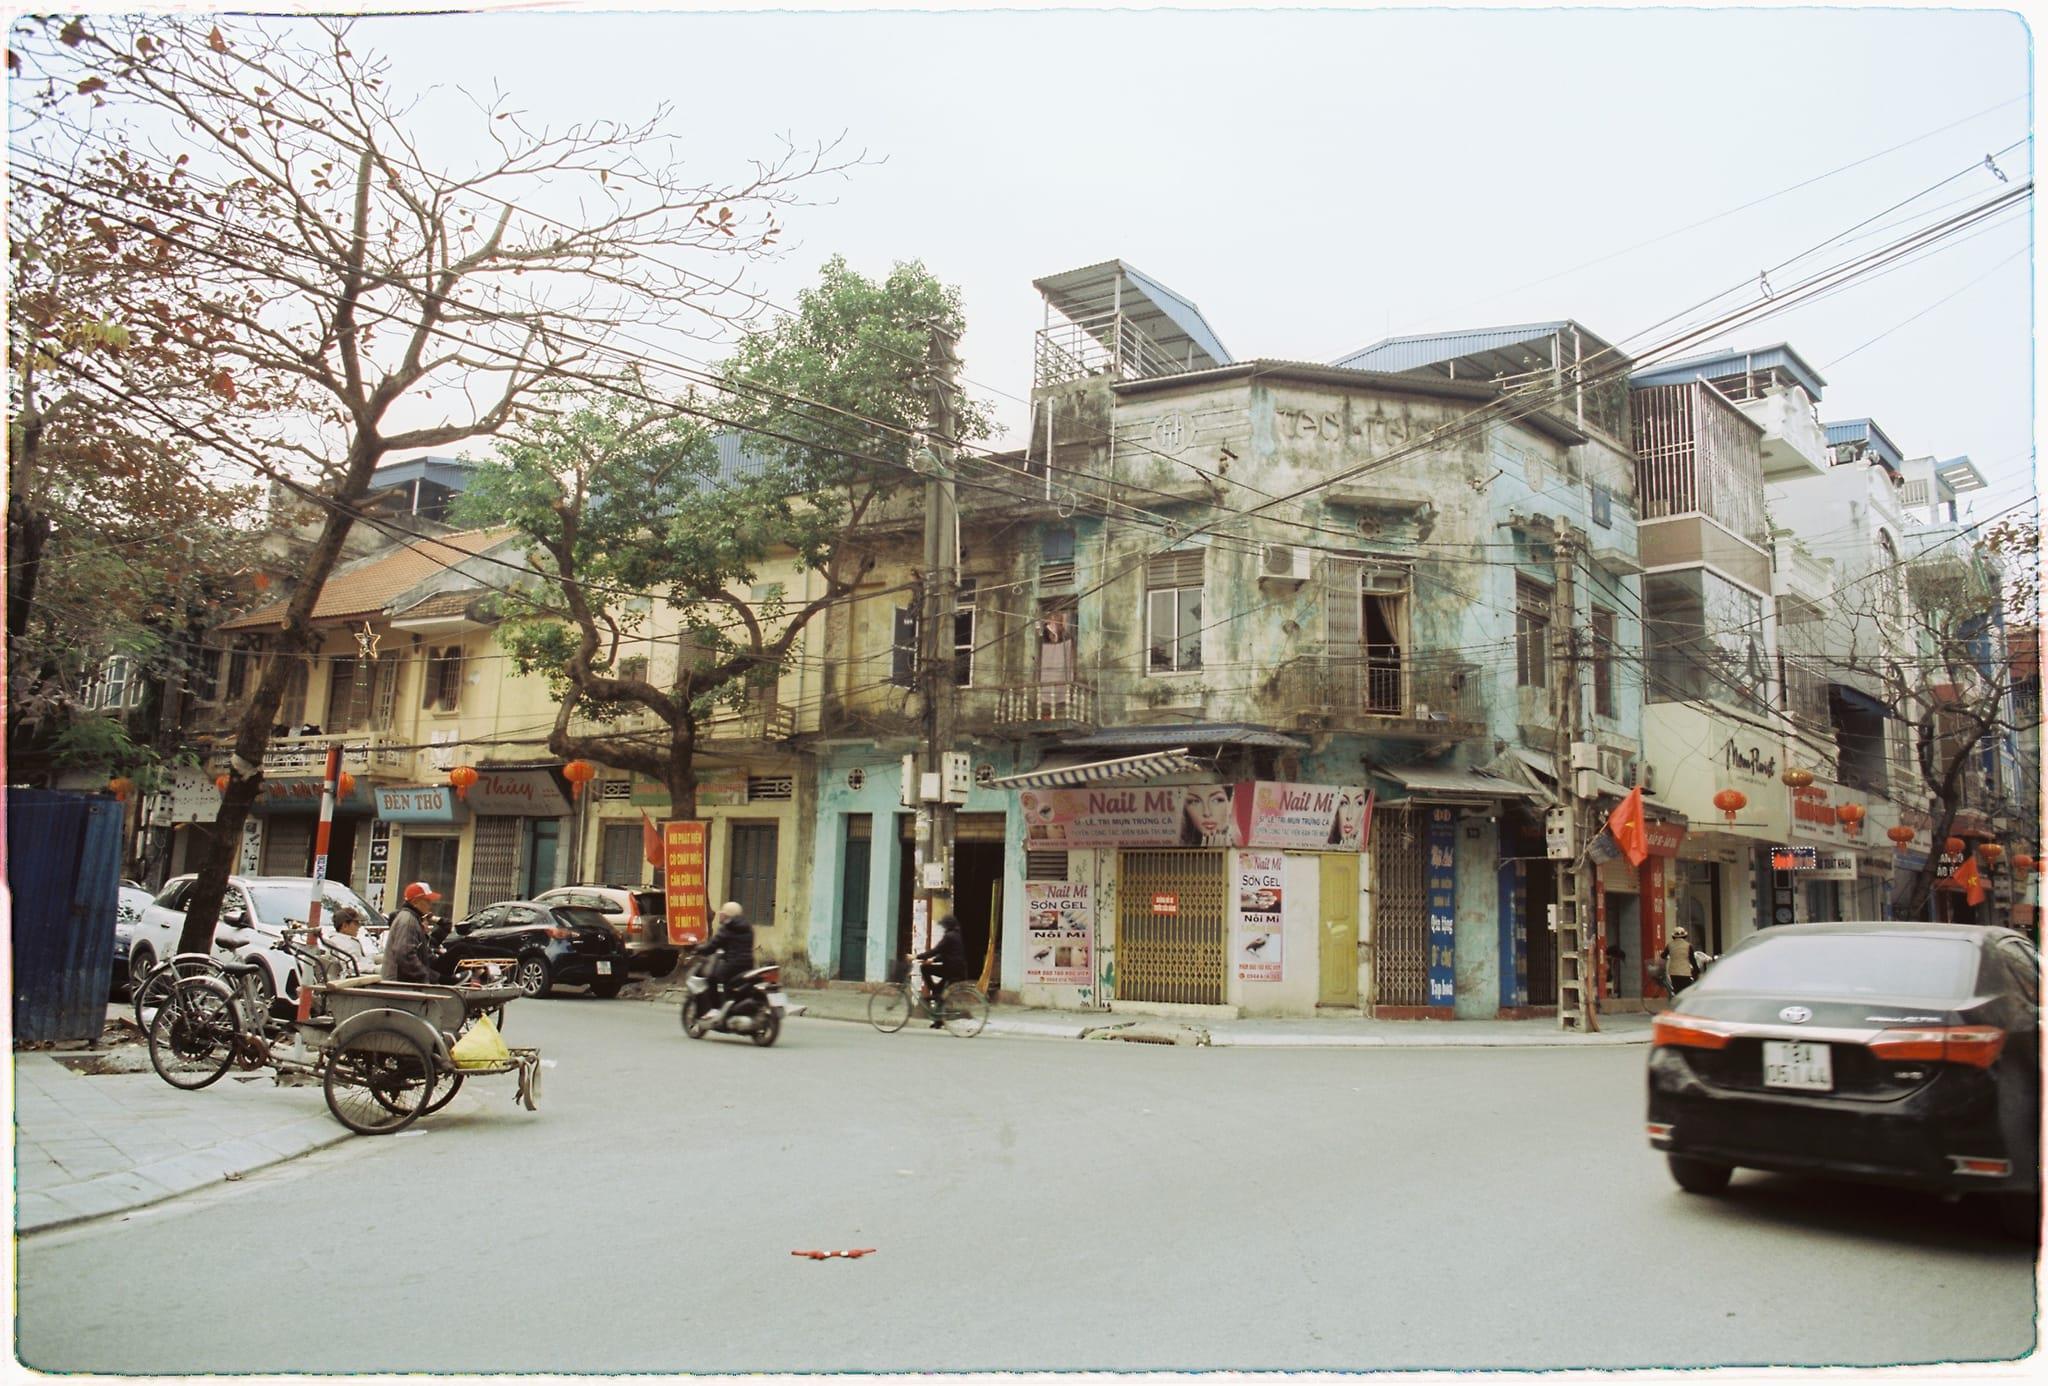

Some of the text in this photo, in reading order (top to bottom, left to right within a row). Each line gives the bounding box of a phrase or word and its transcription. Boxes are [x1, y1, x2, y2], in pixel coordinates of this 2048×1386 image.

[1088, 791, 1137, 814] Nail
[1144, 790, 1175, 813] Mi
[1280, 791, 1312, 811] Nail
[1314, 792, 1335, 813] Mi
[1254, 856, 1282, 870] Nail Mi
[1242, 875, 1280, 887] SƠN GEL
[1047, 884, 1088, 898] Nail Mi
[1031, 900, 1087, 910] SƠN GEL
[1266, 915, 1279, 923] Mi
